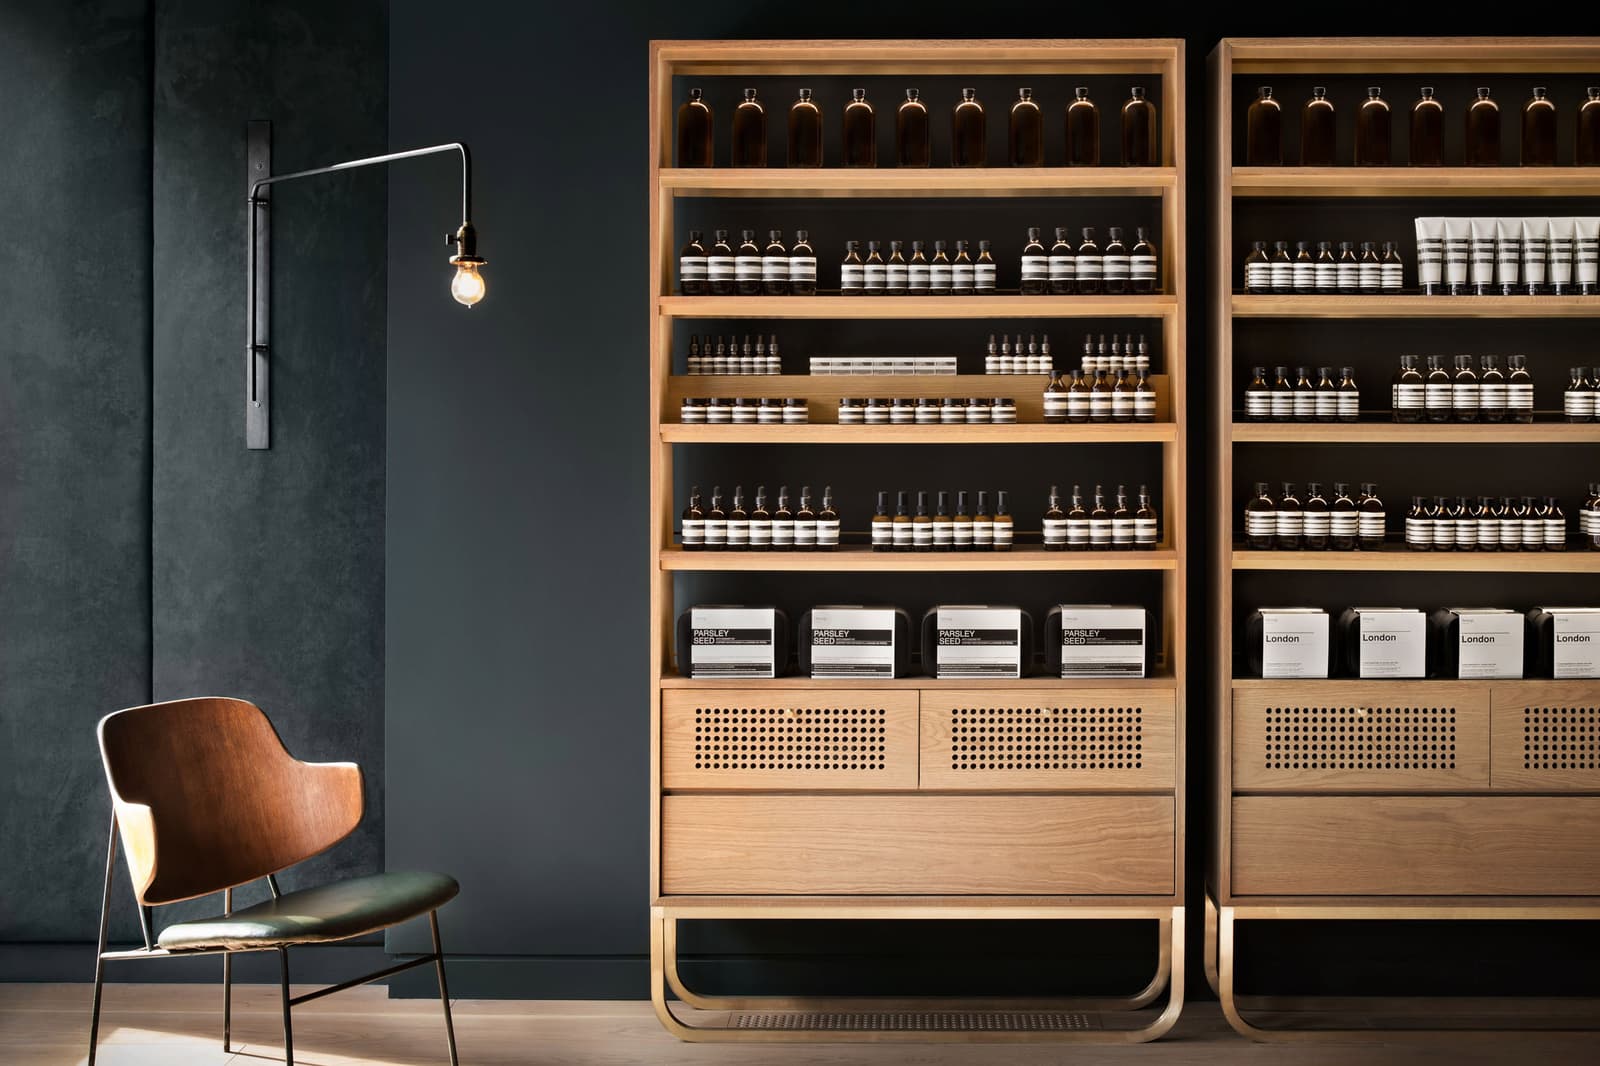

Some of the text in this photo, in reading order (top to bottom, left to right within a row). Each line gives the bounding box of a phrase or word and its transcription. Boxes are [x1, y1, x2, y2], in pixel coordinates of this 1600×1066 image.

[1266, 634, 1300, 642] London
[1362, 634, 1396, 642] London
[1461, 635, 1495, 643] London
[1556, 634, 1590, 642] London
